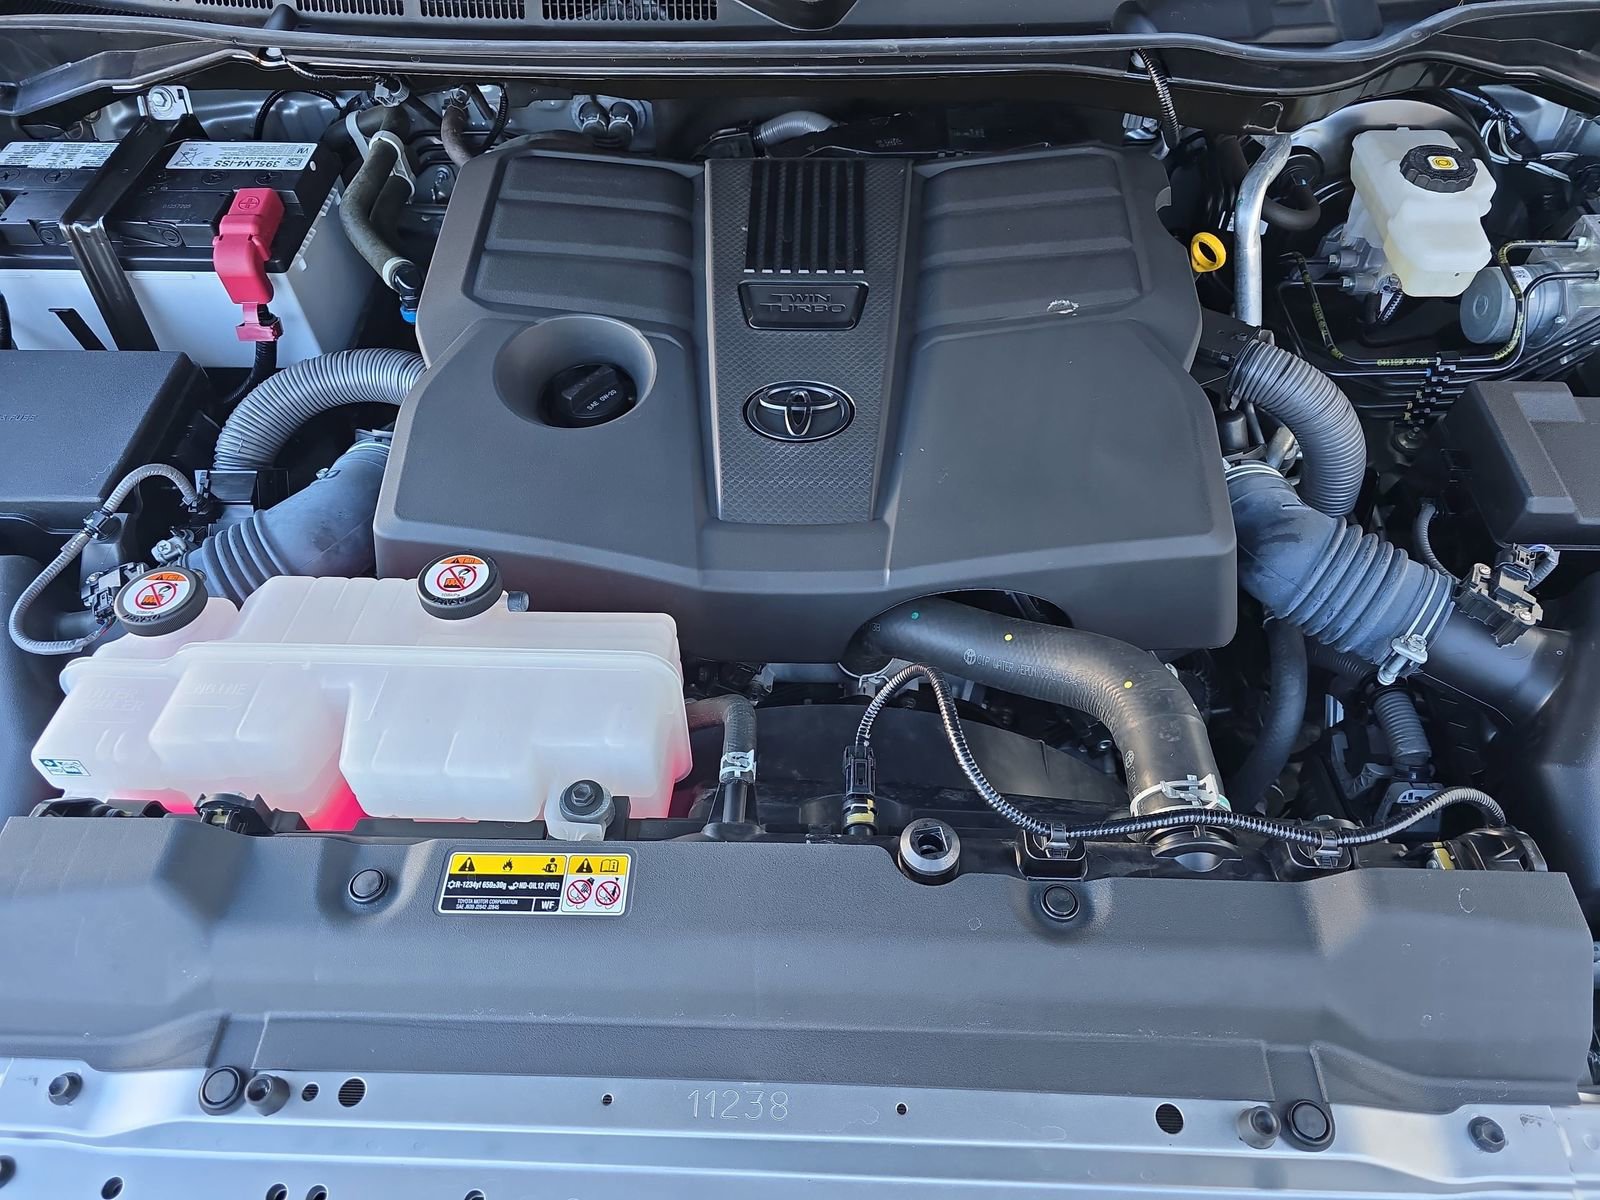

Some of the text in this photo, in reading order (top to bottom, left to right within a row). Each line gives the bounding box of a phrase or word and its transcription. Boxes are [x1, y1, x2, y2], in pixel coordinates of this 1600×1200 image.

[771, 293, 831, 303] TWIN
[760, 303, 847, 313] TURBO
[586, 389, 617, 411] SAE 0W-20
[992, 659, 1014, 673] WATER
[544, 882, 560, 891] (POE)
[541, 900, 556, 910] WF
[687, 1089, 789, 1122] 11238
